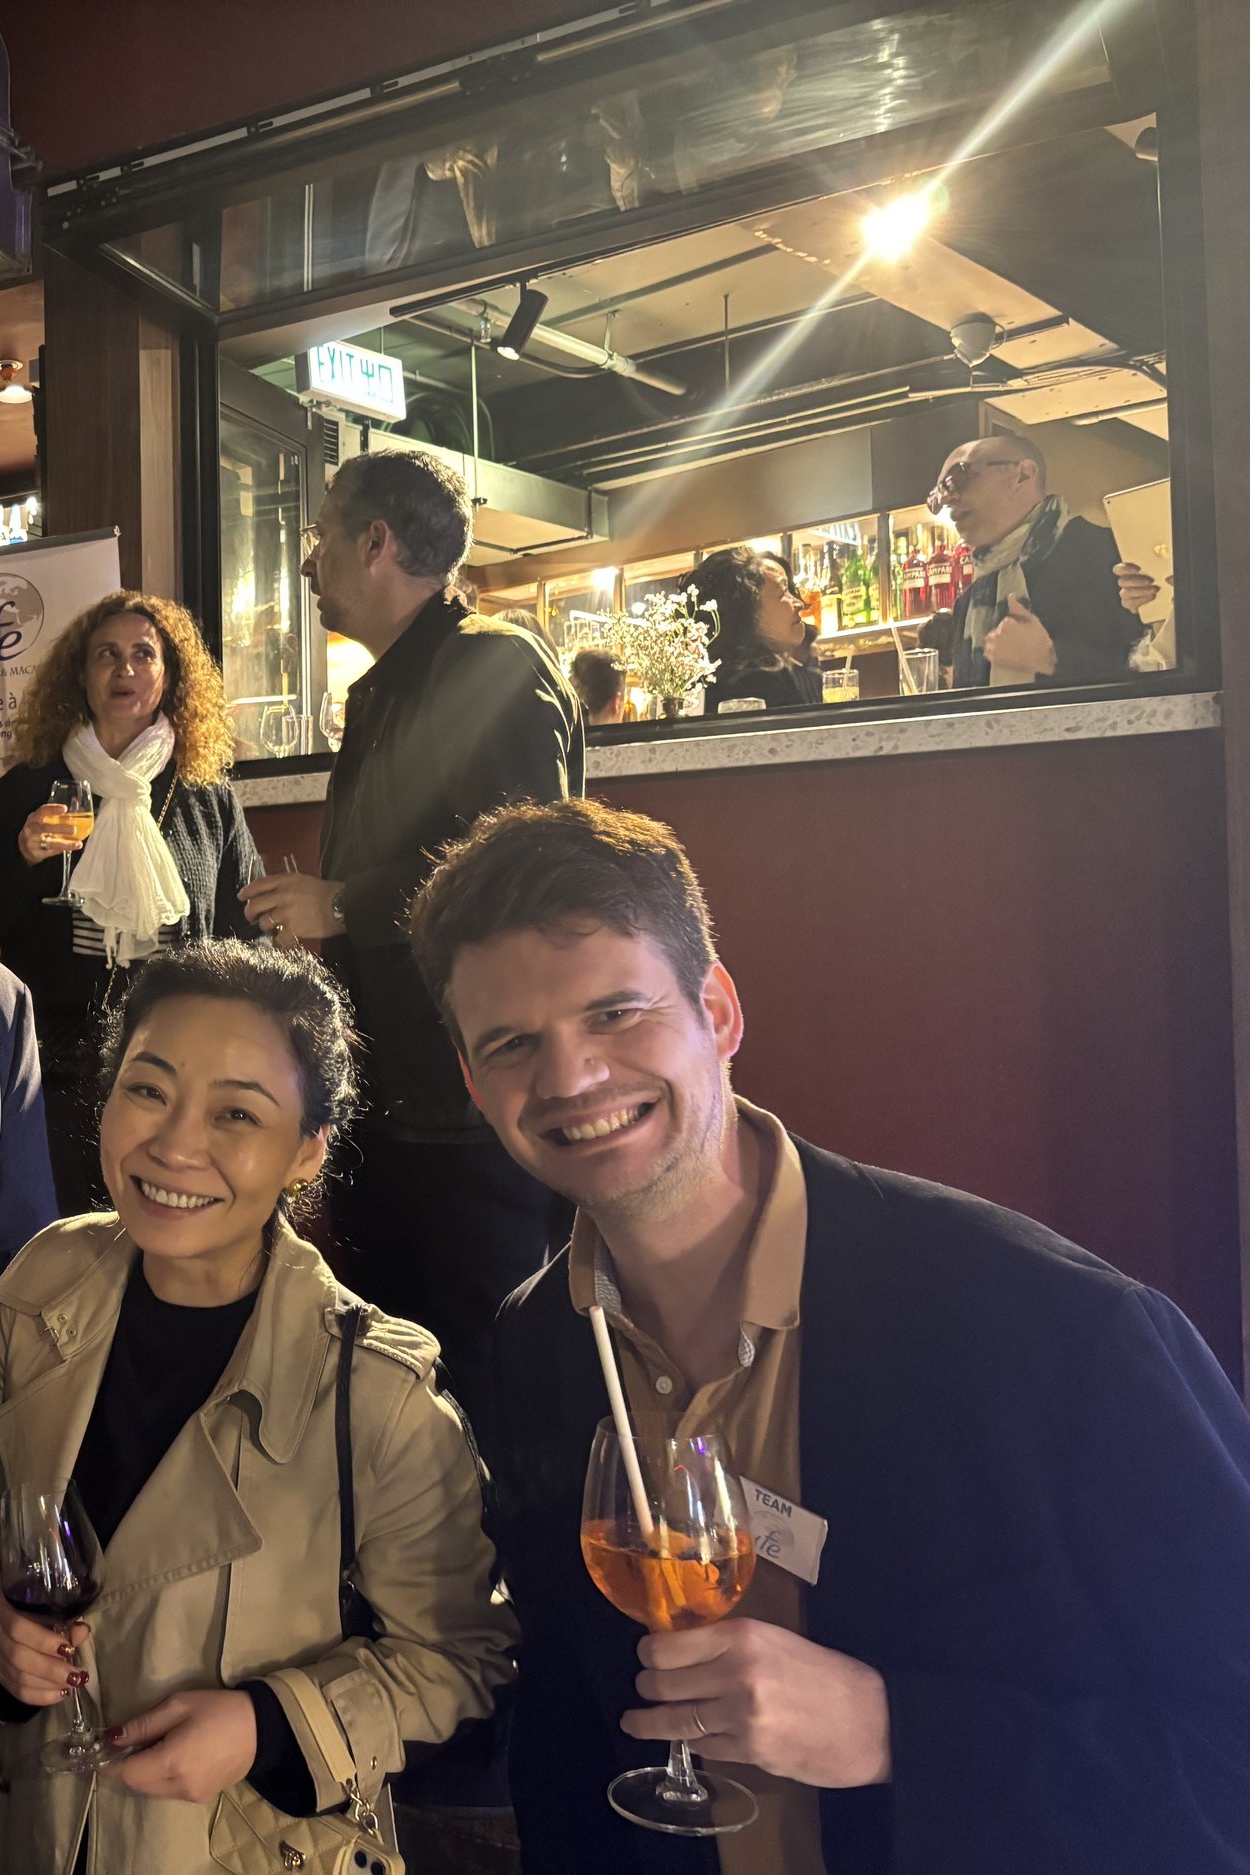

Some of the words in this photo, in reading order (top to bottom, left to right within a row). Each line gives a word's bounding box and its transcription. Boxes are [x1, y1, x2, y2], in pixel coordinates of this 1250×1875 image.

[316, 344, 355, 384] EXIT
[0, 667, 7, 678] &
[9, 692, 17, 710] à
[755, 1488, 793, 1518] TEAM
